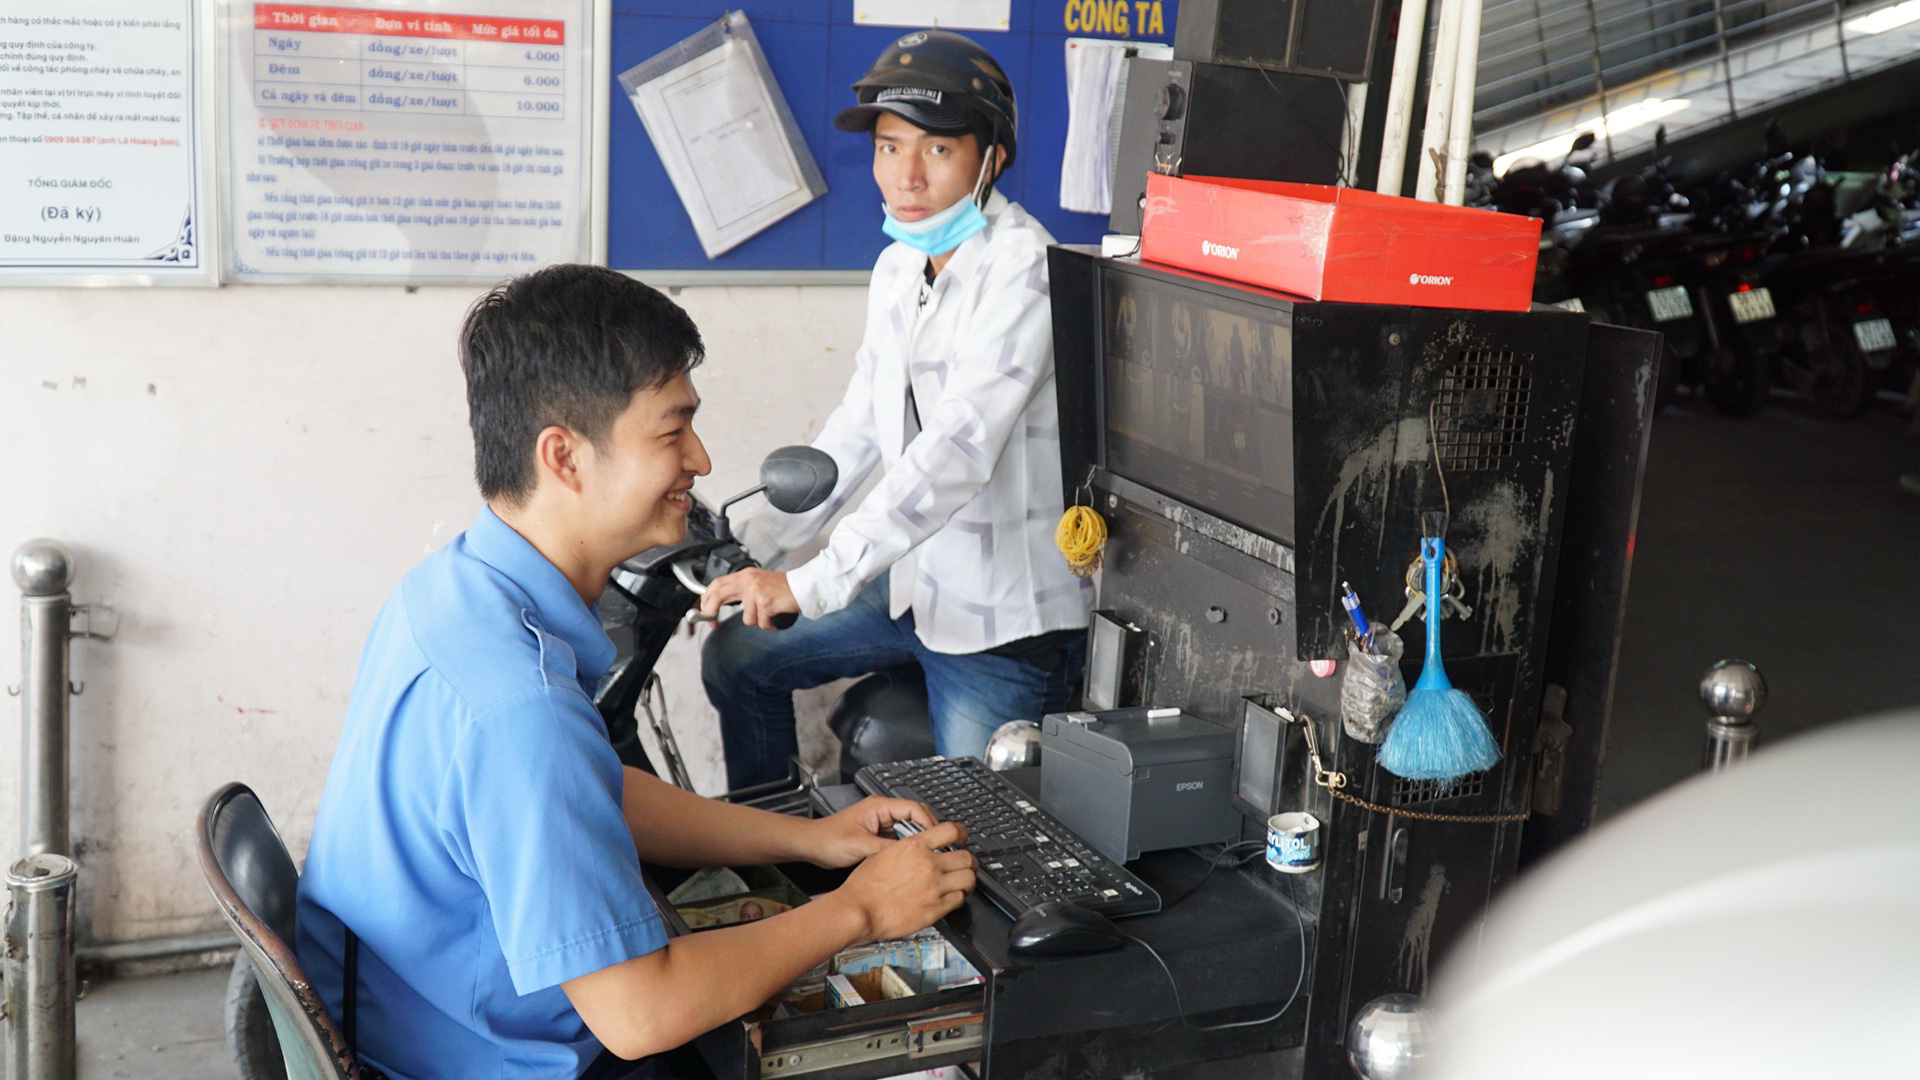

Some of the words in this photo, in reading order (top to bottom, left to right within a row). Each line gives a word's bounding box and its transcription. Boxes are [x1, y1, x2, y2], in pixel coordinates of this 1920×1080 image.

[272, 12, 305, 24] Thời
[308, 15, 340, 28] gian
[375, 16, 403, 30] Đơn
[424, 20, 452, 33] tính
[472, 23, 498, 35] Mức
[501, 24, 520, 38] giá
[522, 24, 540, 37] tối
[268, 36, 302, 51] Ngày
[524, 51, 560, 62] 4.000
[268, 63, 301, 75] Đêm
[523, 76, 560, 87] 6.000
[312, 92, 327, 103] và
[516, 101, 560, 112] 10.000
[60, 177, 87, 188] GIÁM
[89, 176, 113, 189] ĐỐC
[41, 206, 69, 222] (Đã
[1211, 243, 1239, 260] ORION
[1421, 275, 1451, 286] ORION
[1176, 781, 1204, 792] EPSON
